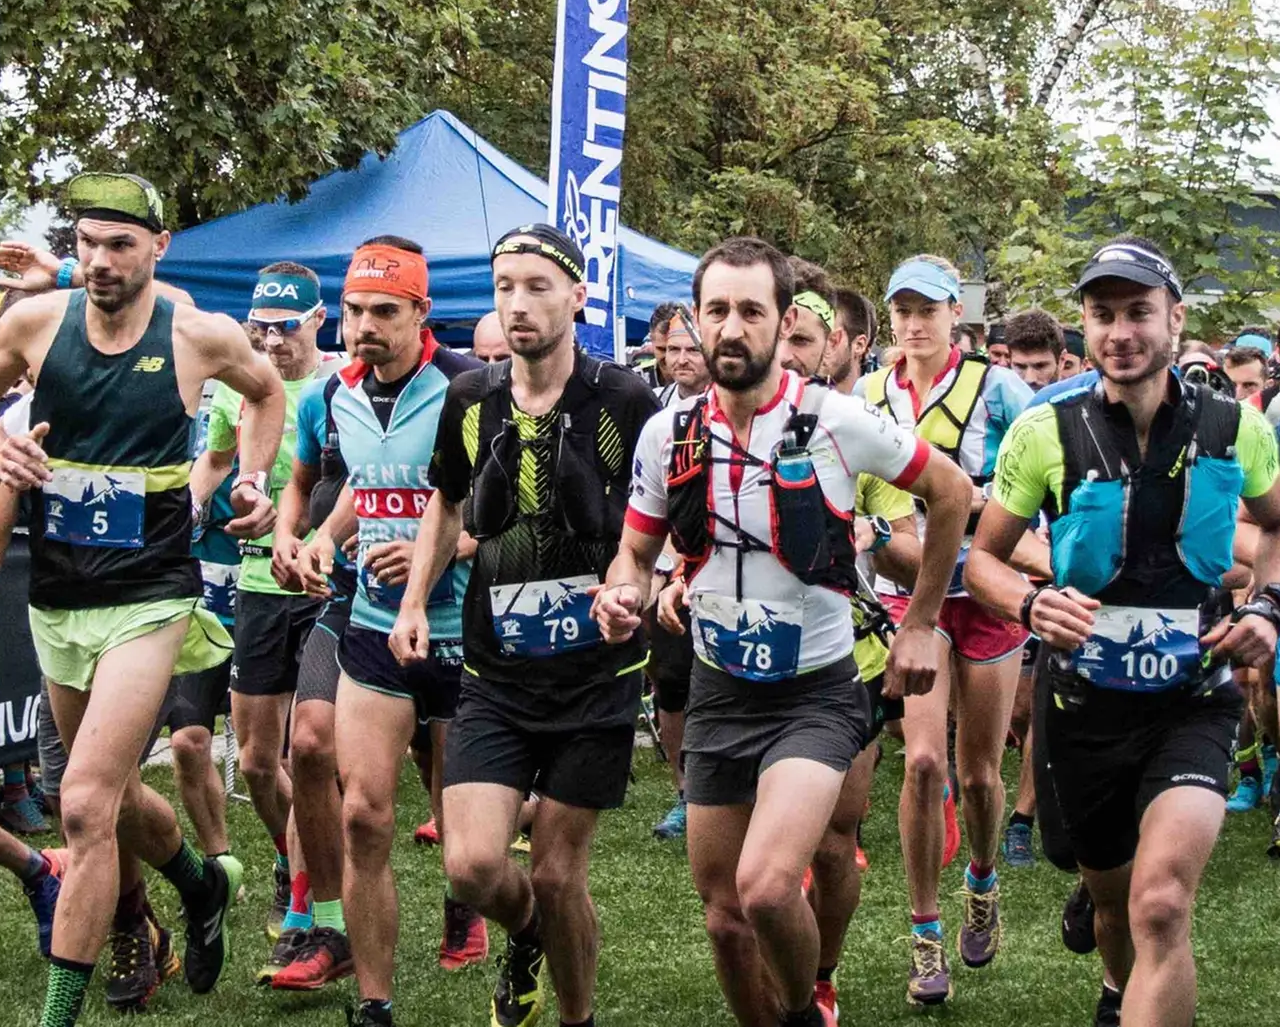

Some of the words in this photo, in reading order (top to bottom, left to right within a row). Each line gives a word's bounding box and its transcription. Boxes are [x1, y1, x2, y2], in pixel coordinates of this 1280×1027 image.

[253, 282, 298, 300] BOA
[92, 510, 108, 535] 5
[544, 616, 579, 643] 79
[738, 640, 772, 670] 78
[1121, 651, 1178, 680] 100
